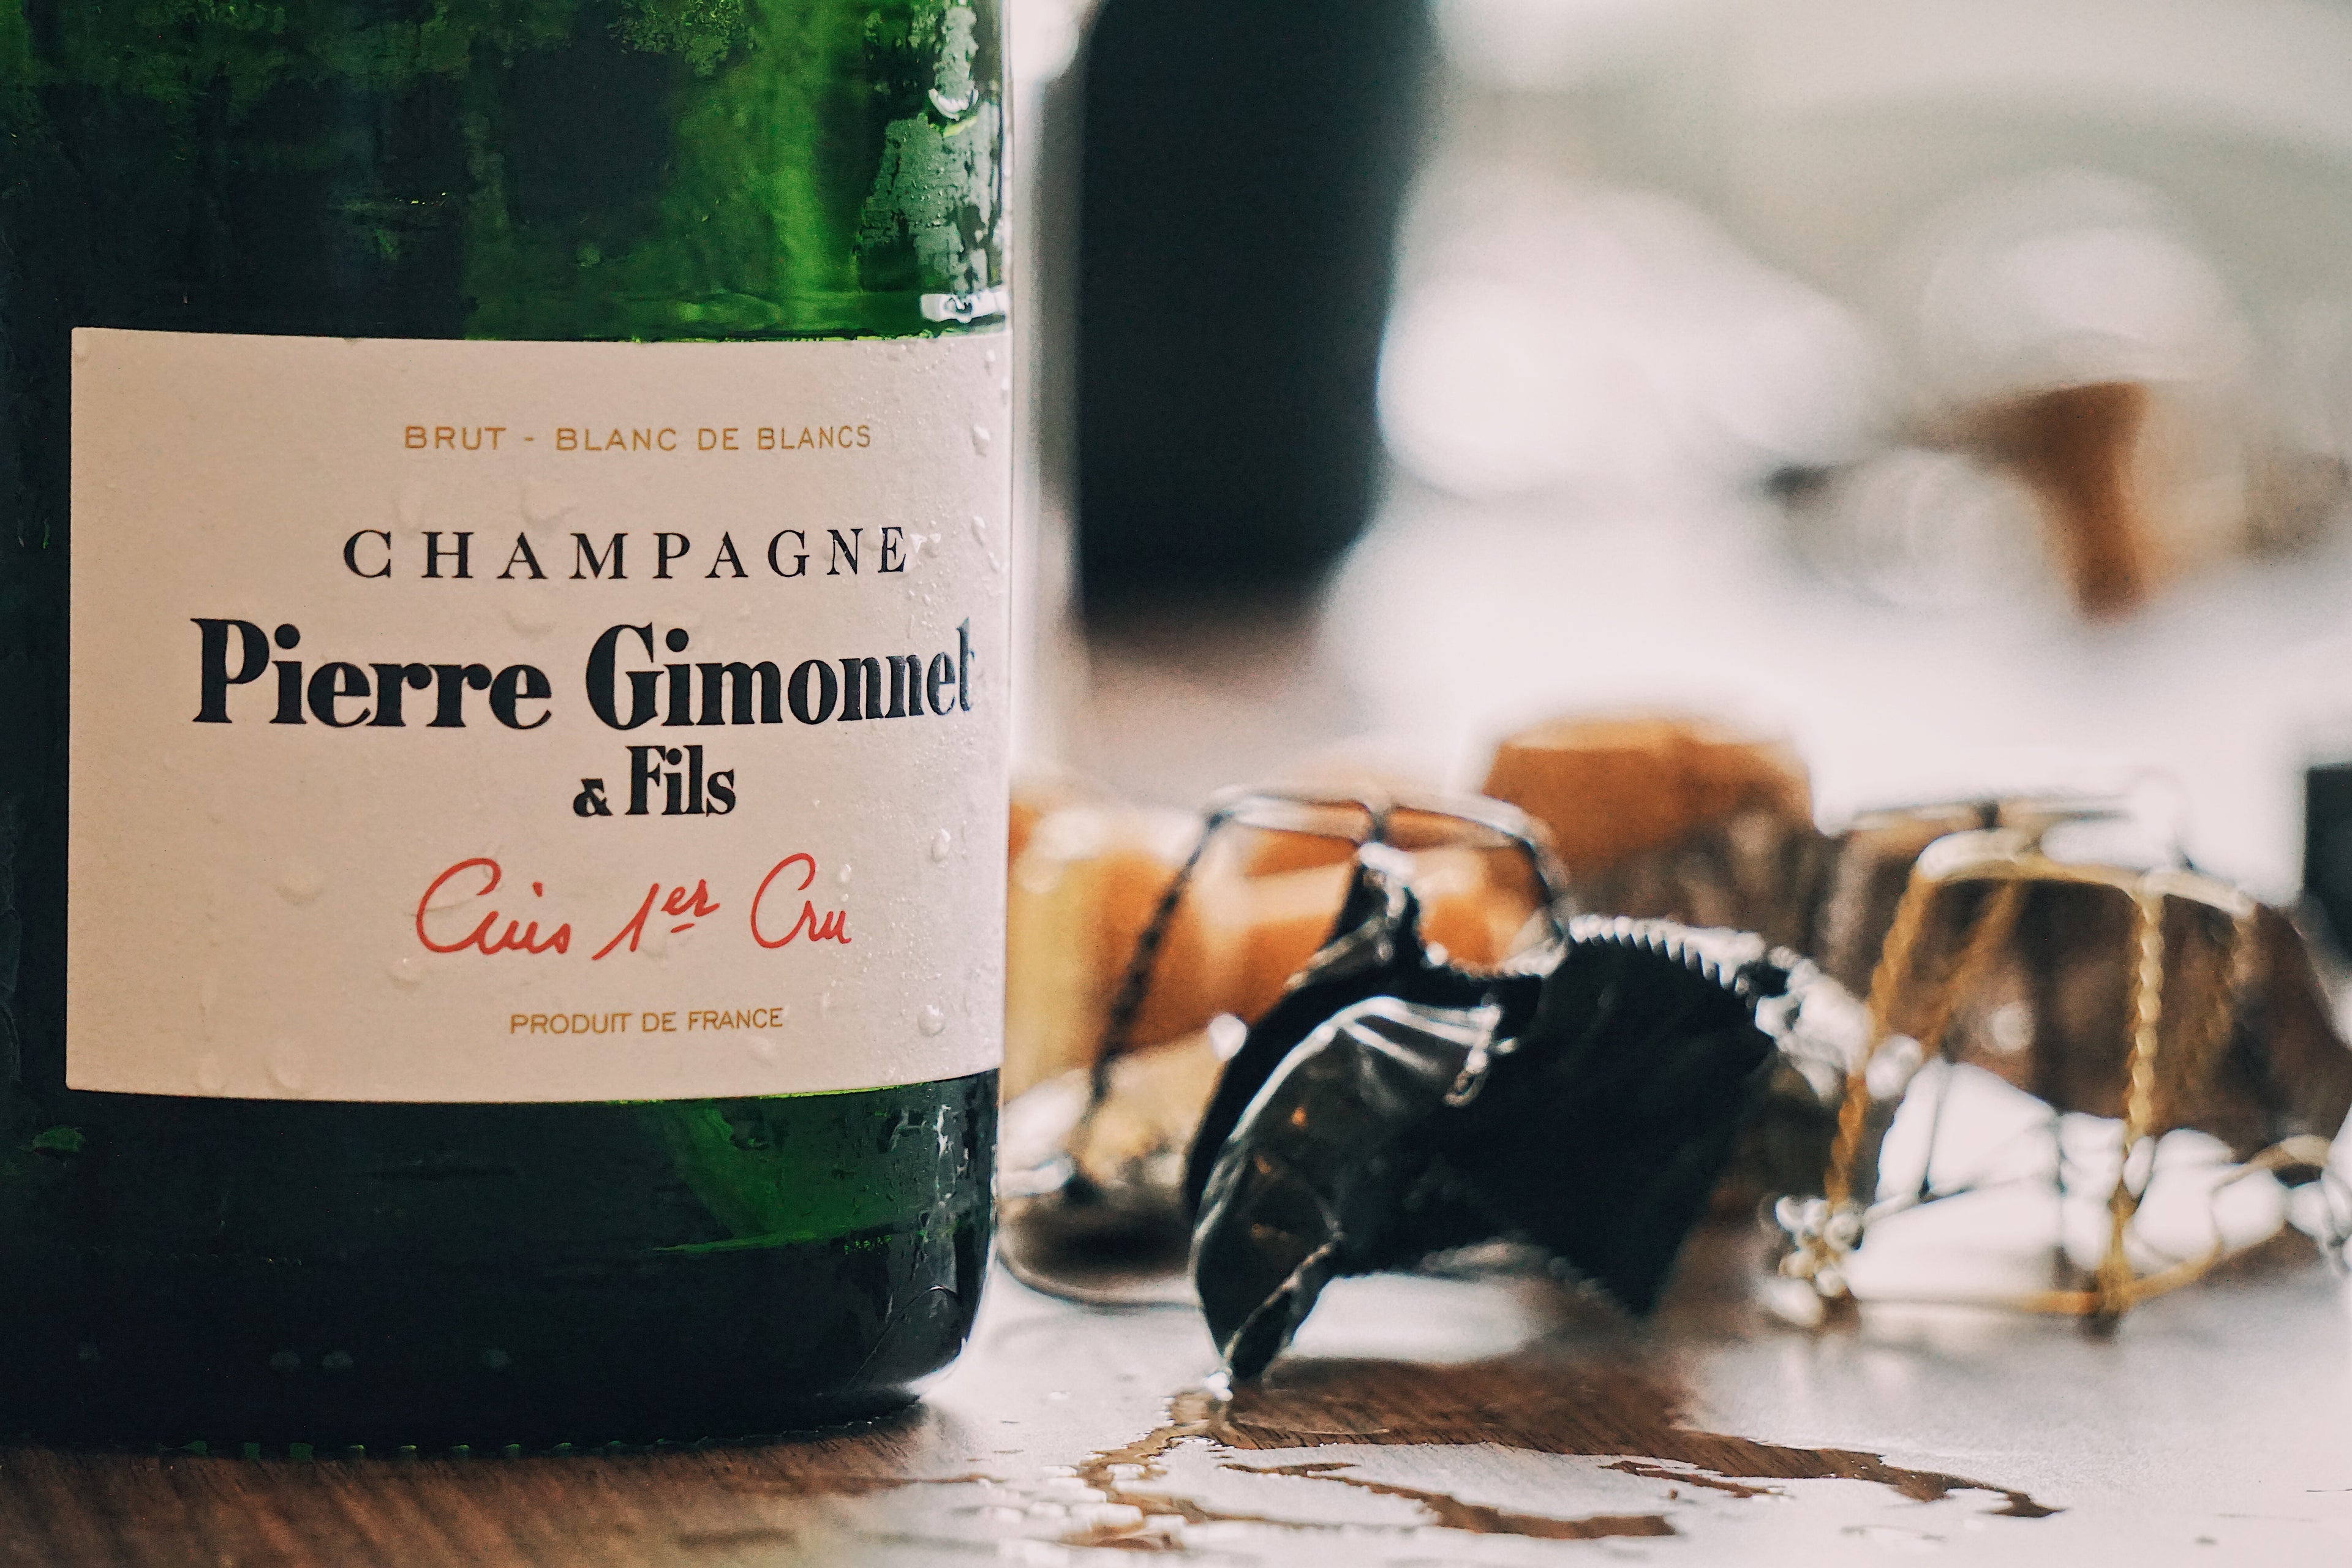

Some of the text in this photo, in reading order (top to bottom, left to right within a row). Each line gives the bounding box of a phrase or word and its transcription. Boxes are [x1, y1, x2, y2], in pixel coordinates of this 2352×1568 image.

[405, 426, 505, 450] BRUT
[556, 428, 676, 451] BLANC
[698, 428, 738, 450] DE
[757, 425, 870, 450] BLANCS
[343, 527, 906, 579] CHAMPAGNE
[189, 617, 975, 731] Pierre Gimonnet
[572, 744, 736, 818] & Fils
[750, 853, 852, 949] Cru
[510, 1008, 783, 1034] PRODUIT DE FRANCE
